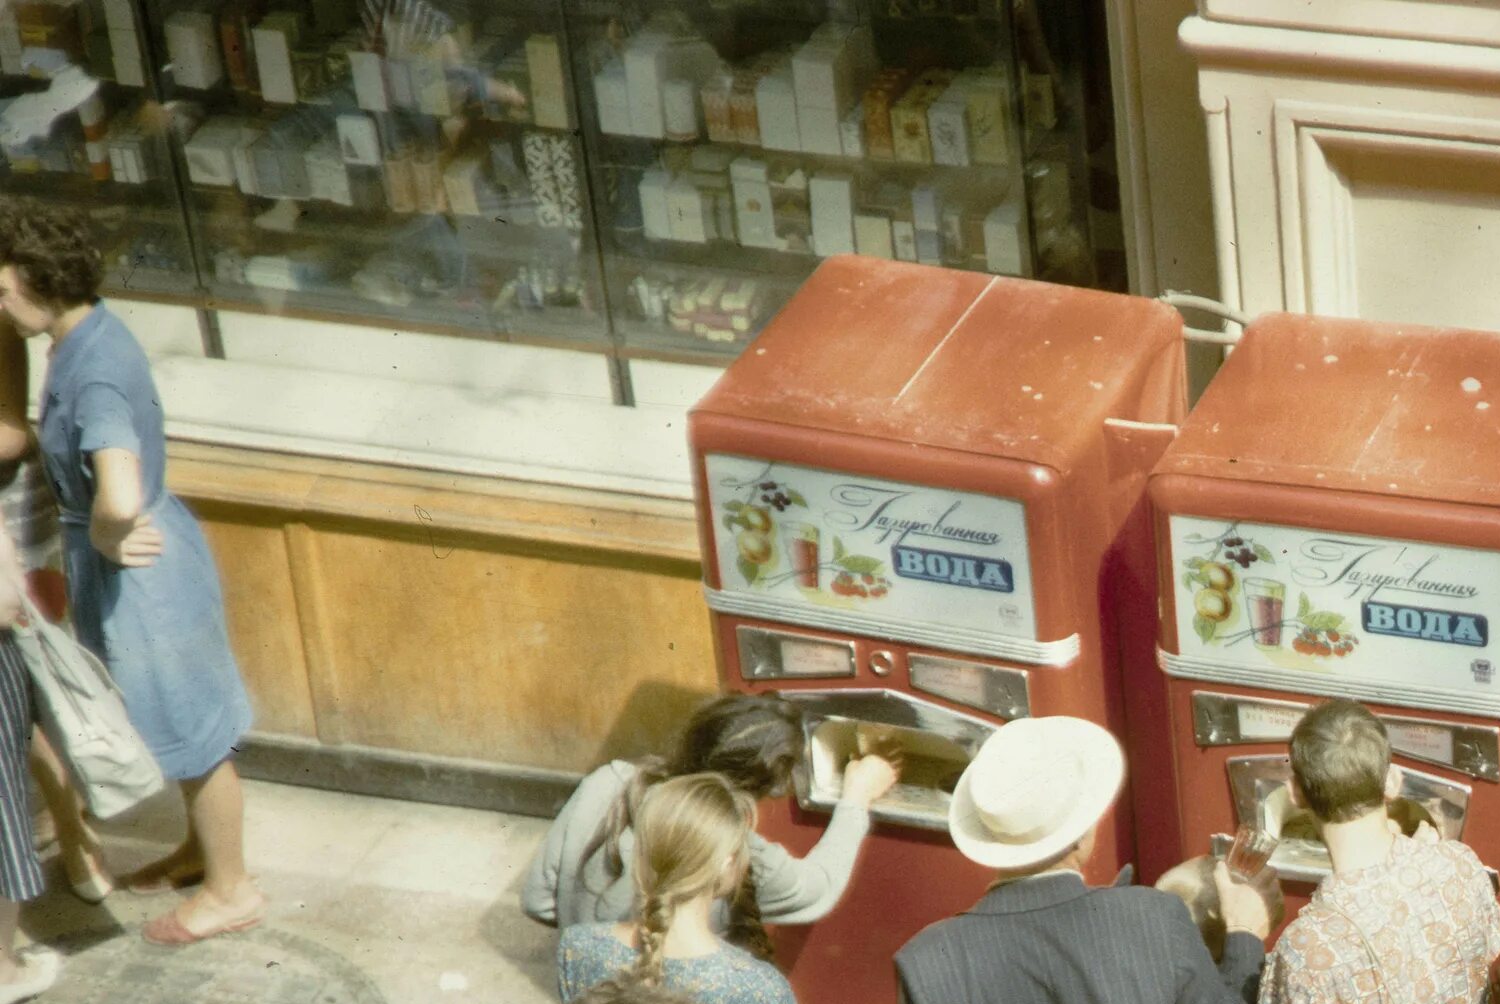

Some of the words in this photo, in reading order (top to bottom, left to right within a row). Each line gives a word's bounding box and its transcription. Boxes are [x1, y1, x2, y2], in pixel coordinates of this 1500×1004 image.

[824, 483, 1003, 545] Газированная
[898, 549, 1008, 587] ВОДА
[1291, 538, 1480, 600] Газированная
[1367, 604, 1483, 643] ВОДА
